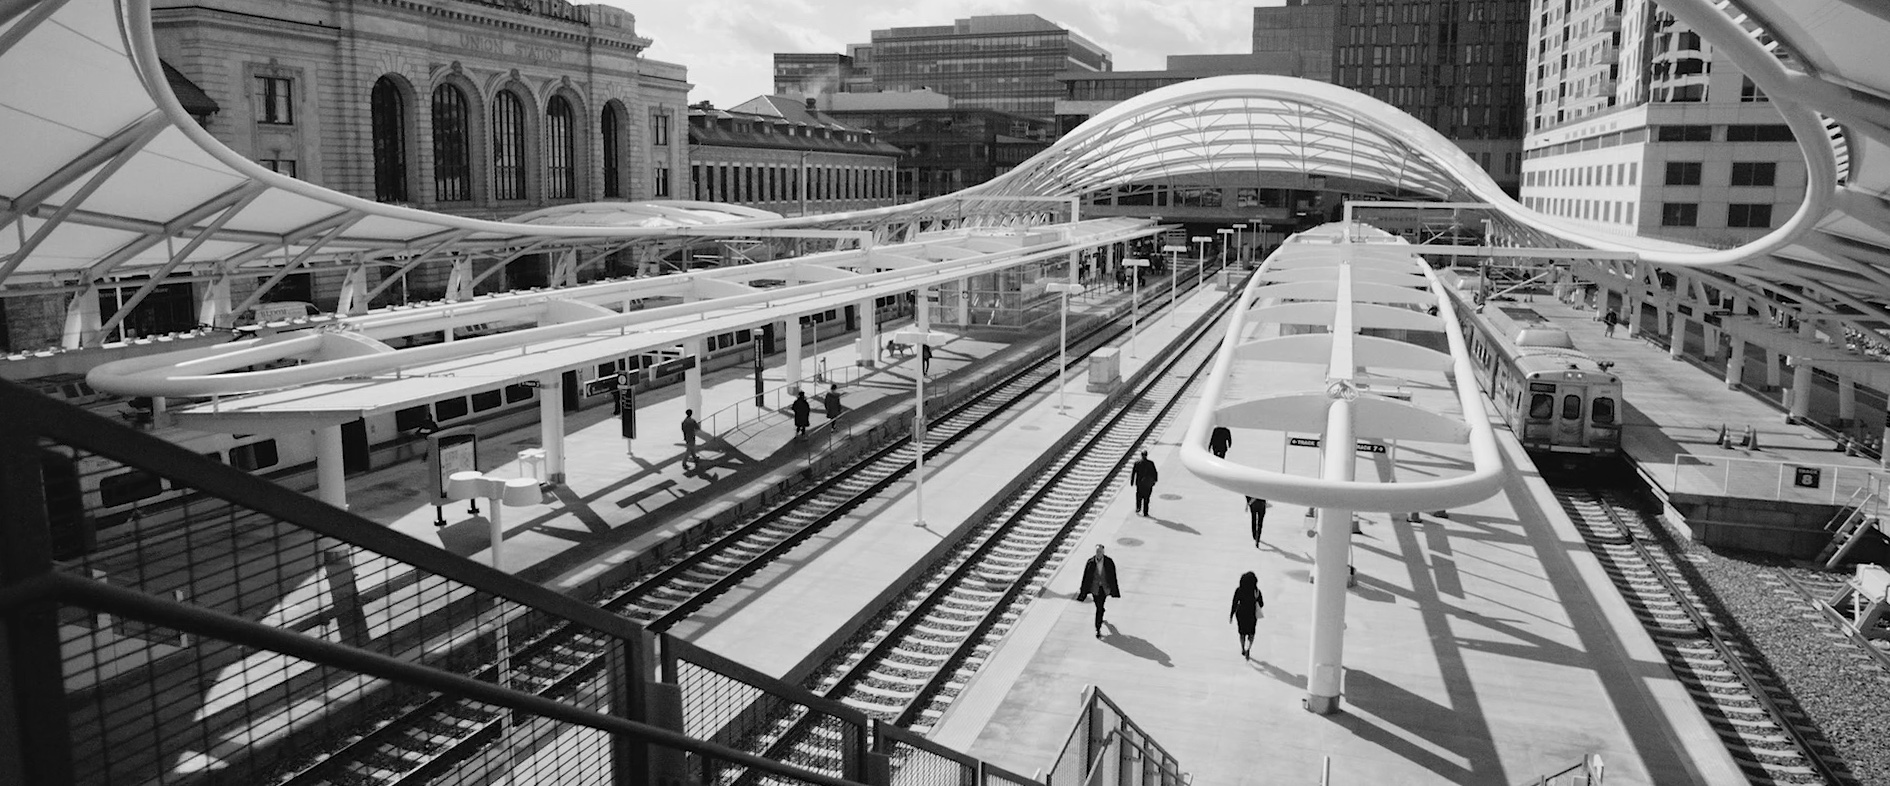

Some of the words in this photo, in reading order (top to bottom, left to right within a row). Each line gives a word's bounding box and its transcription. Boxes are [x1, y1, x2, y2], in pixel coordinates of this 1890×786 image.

[460, 34, 503, 54] UNION
[515, 43, 562, 61] STATION
[1801, 475, 1813, 485] 8
